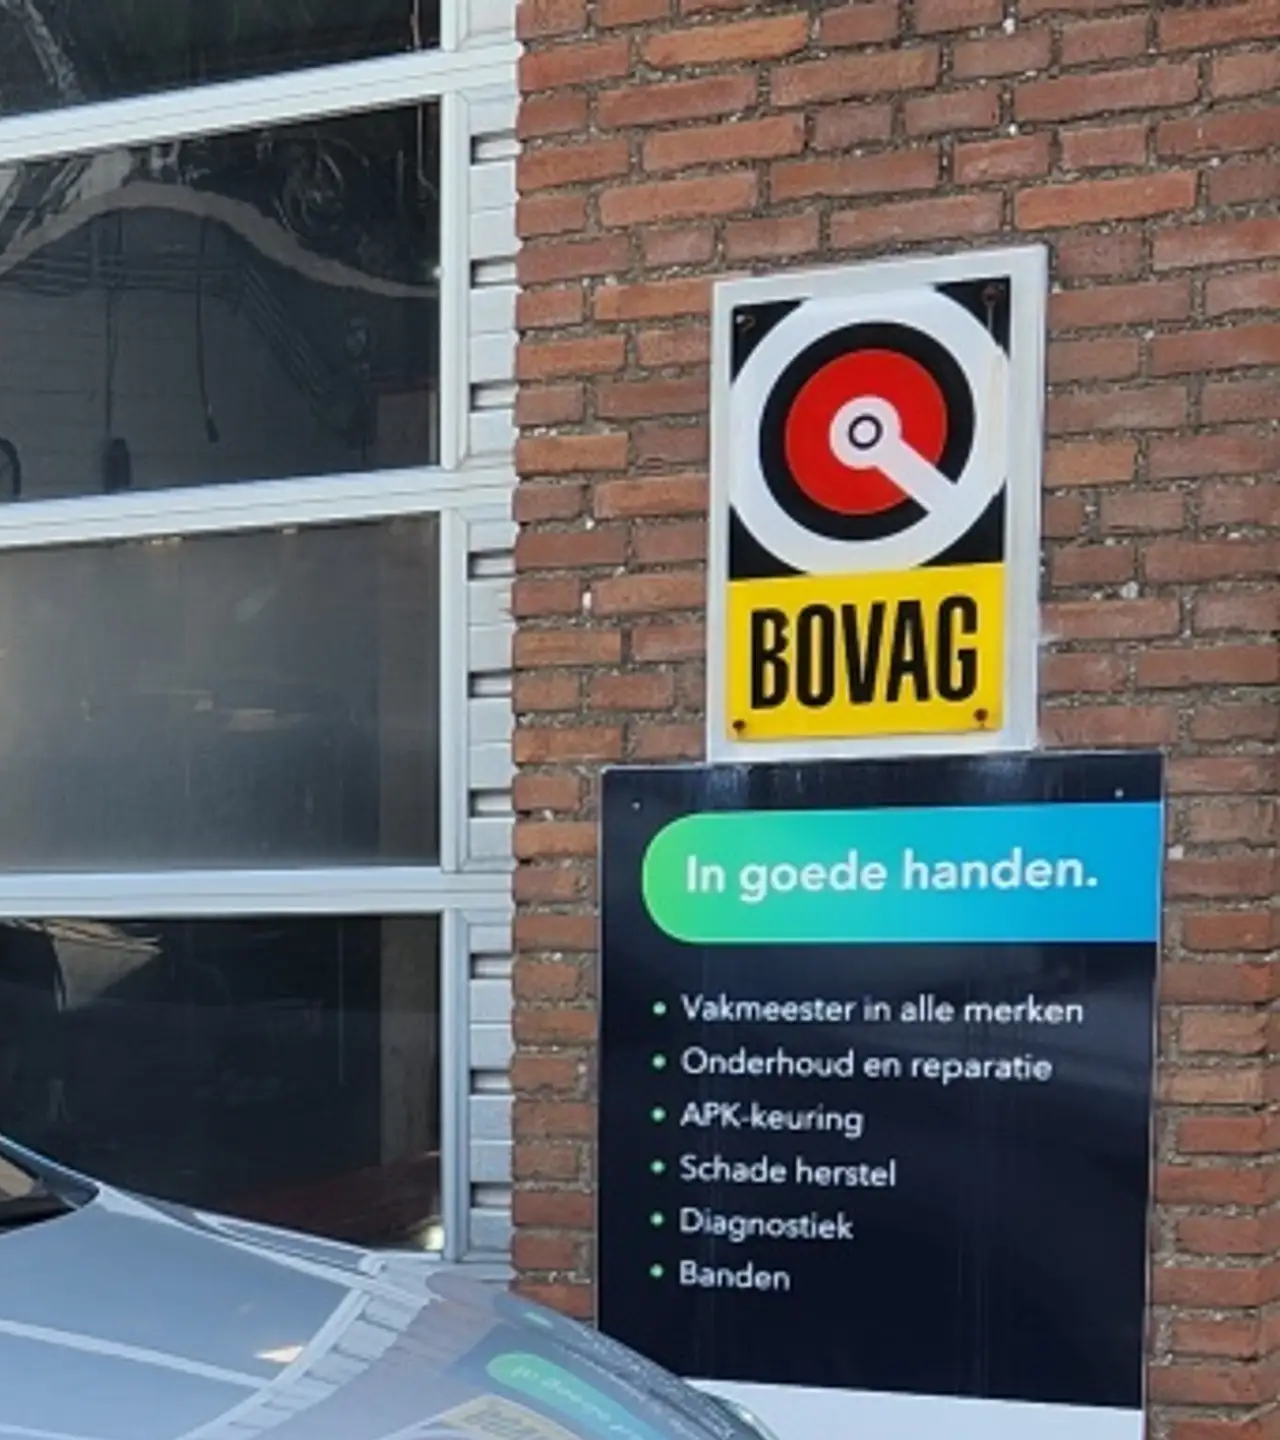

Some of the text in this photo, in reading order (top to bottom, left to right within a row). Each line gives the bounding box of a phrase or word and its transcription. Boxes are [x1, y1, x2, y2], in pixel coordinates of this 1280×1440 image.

[750, 594, 978, 710] BOVAG
[686, 848, 1099, 904] In goede handen.
[681, 994, 1084, 1024] Vakmeester in alle merken
[681, 1046, 1053, 1086] Onderhoud en reparatie
[680, 1102, 864, 1140] APK-keuring
[680, 1155, 897, 1187] Schade herstel
[679, 1208, 854, 1241] Diagnostiek
[679, 1261, 790, 1291] Banden
